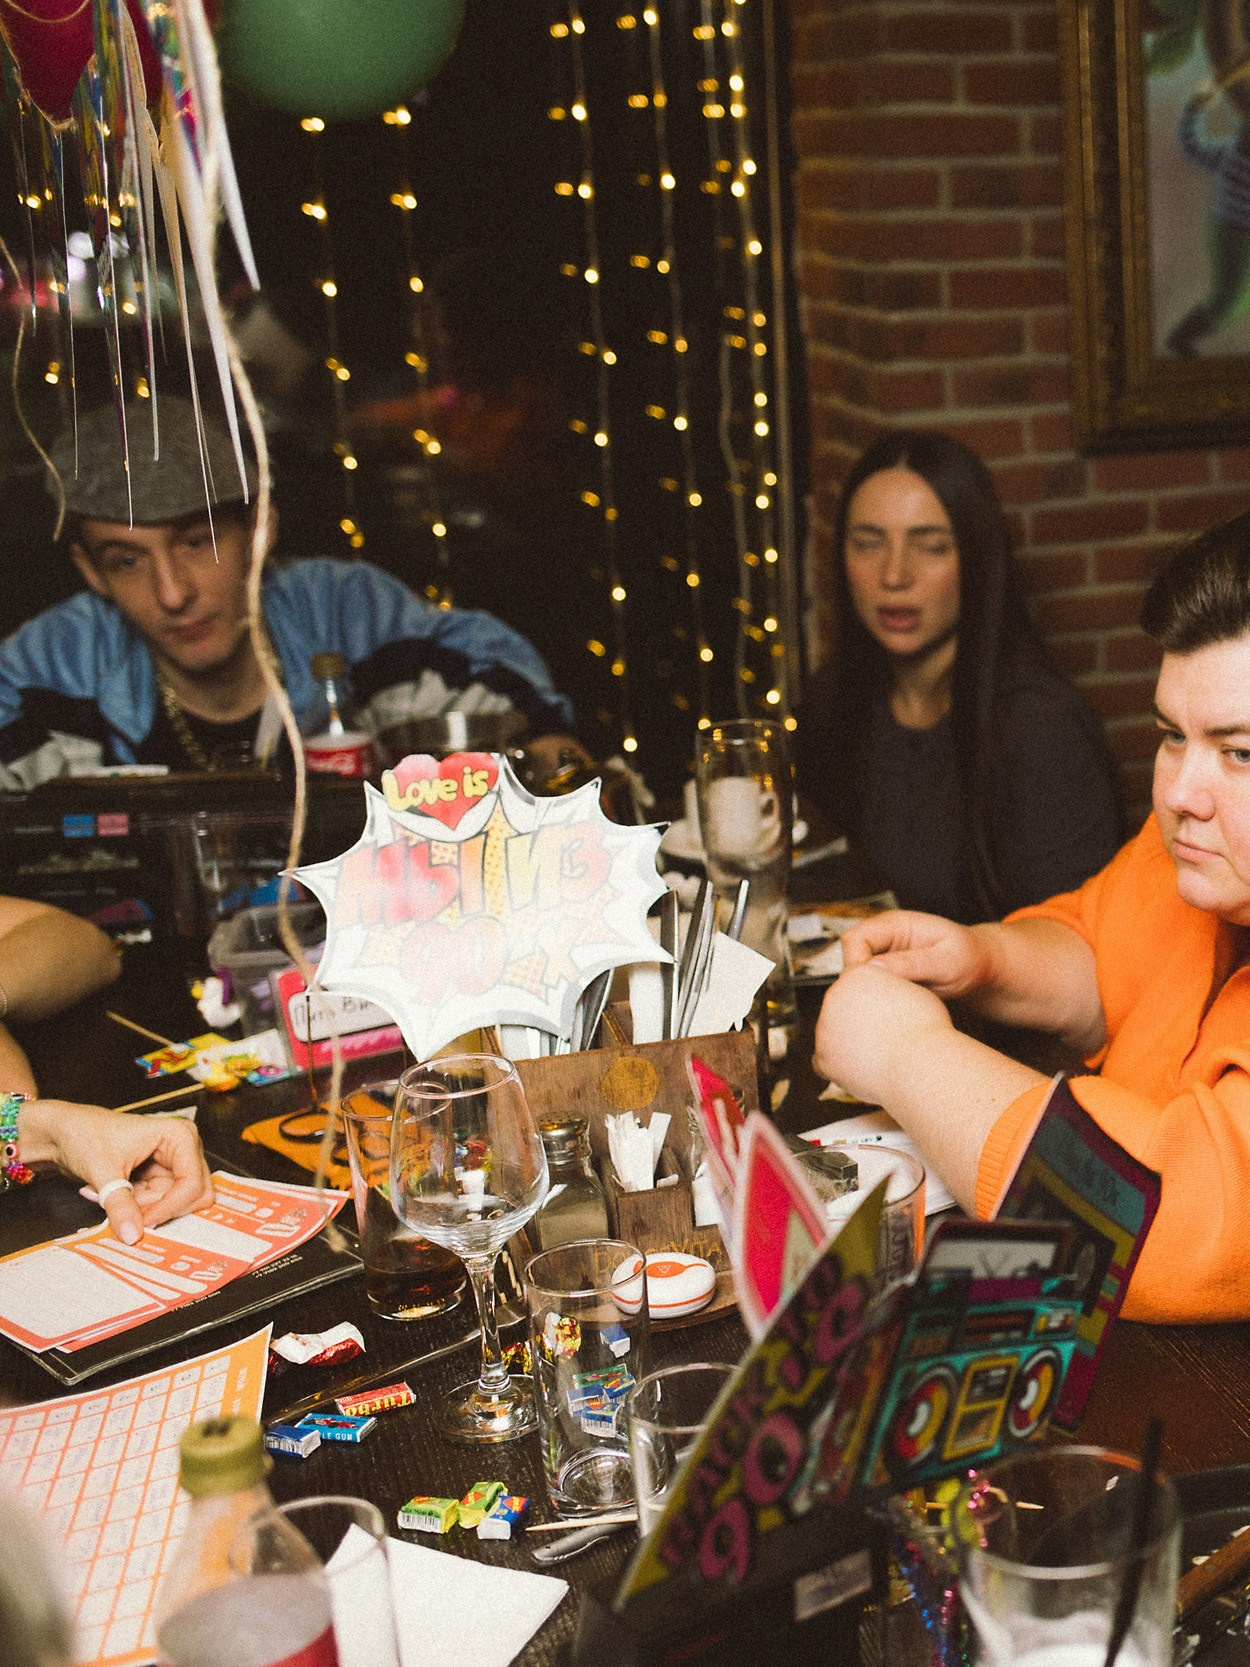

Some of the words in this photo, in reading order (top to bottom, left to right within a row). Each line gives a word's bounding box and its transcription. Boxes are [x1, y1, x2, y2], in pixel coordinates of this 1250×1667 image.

[382, 769, 458, 812] Love
[463, 766, 489, 798] is
[346, 1392, 411, 1416] Turbo
